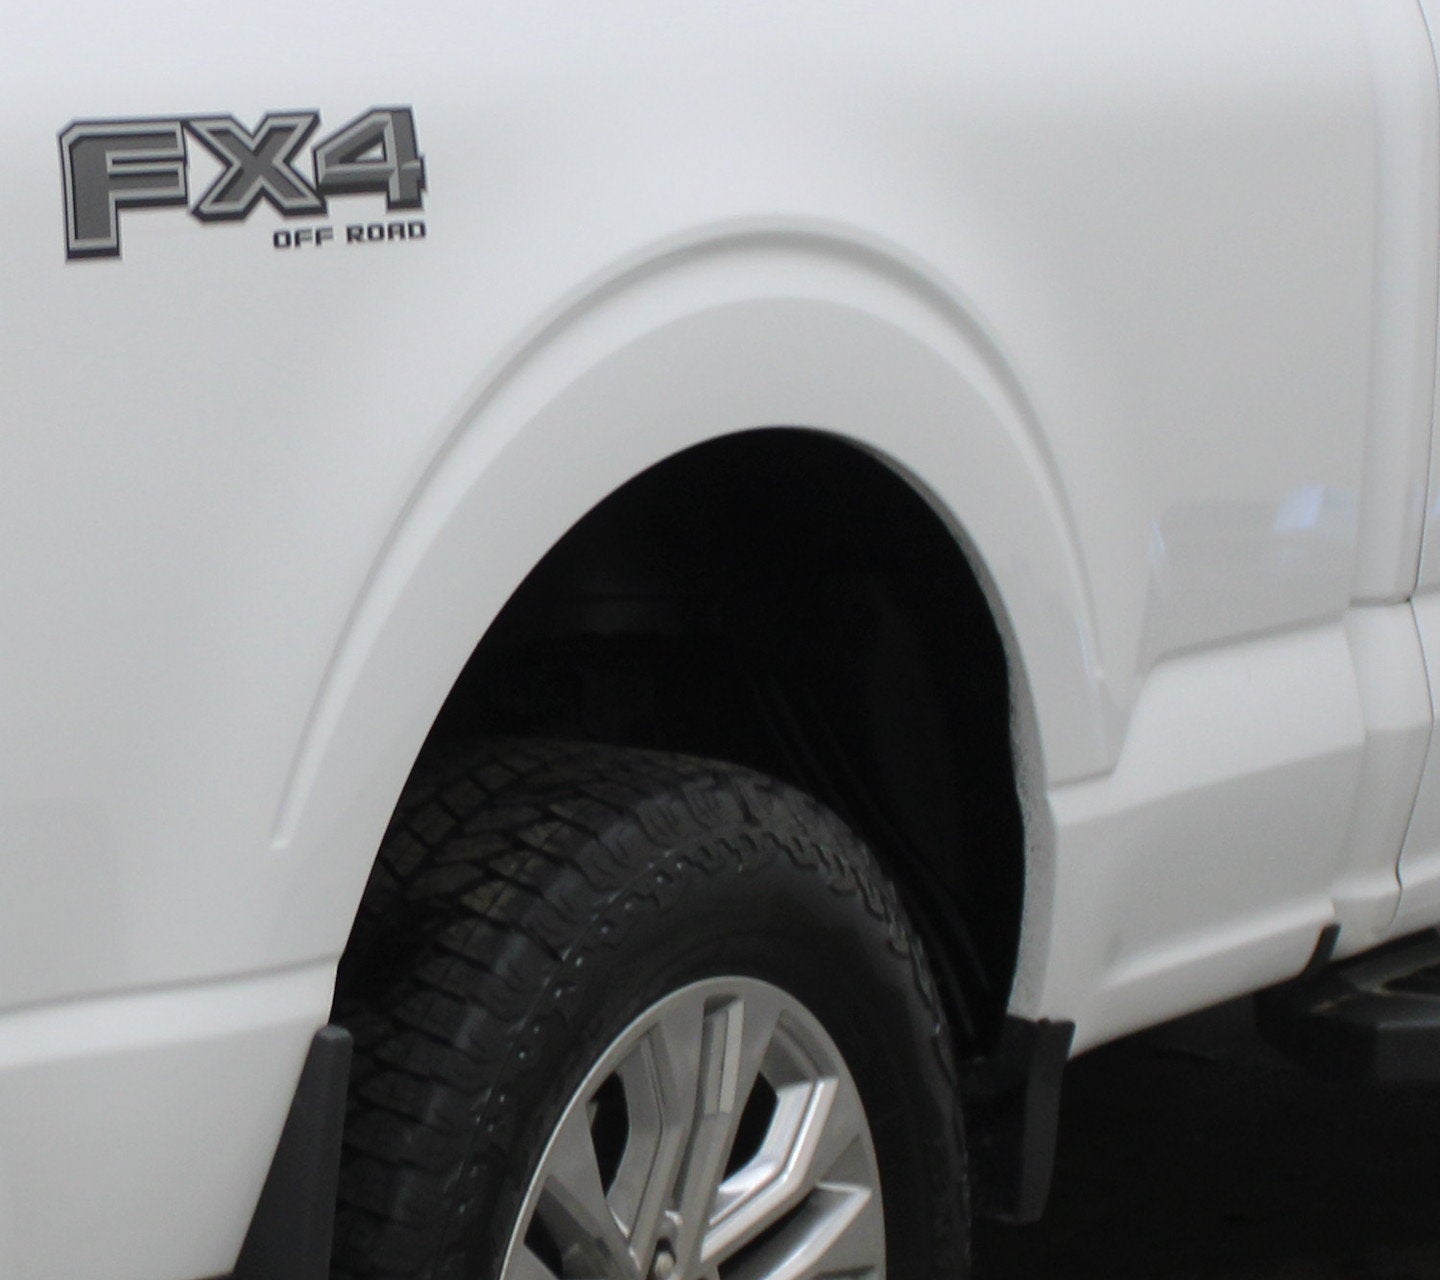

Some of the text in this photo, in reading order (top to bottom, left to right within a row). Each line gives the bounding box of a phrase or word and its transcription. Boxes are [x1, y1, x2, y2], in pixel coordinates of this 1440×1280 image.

[57, 104, 428, 262] FX4
[271, 221, 428, 250] OFF ROAD
